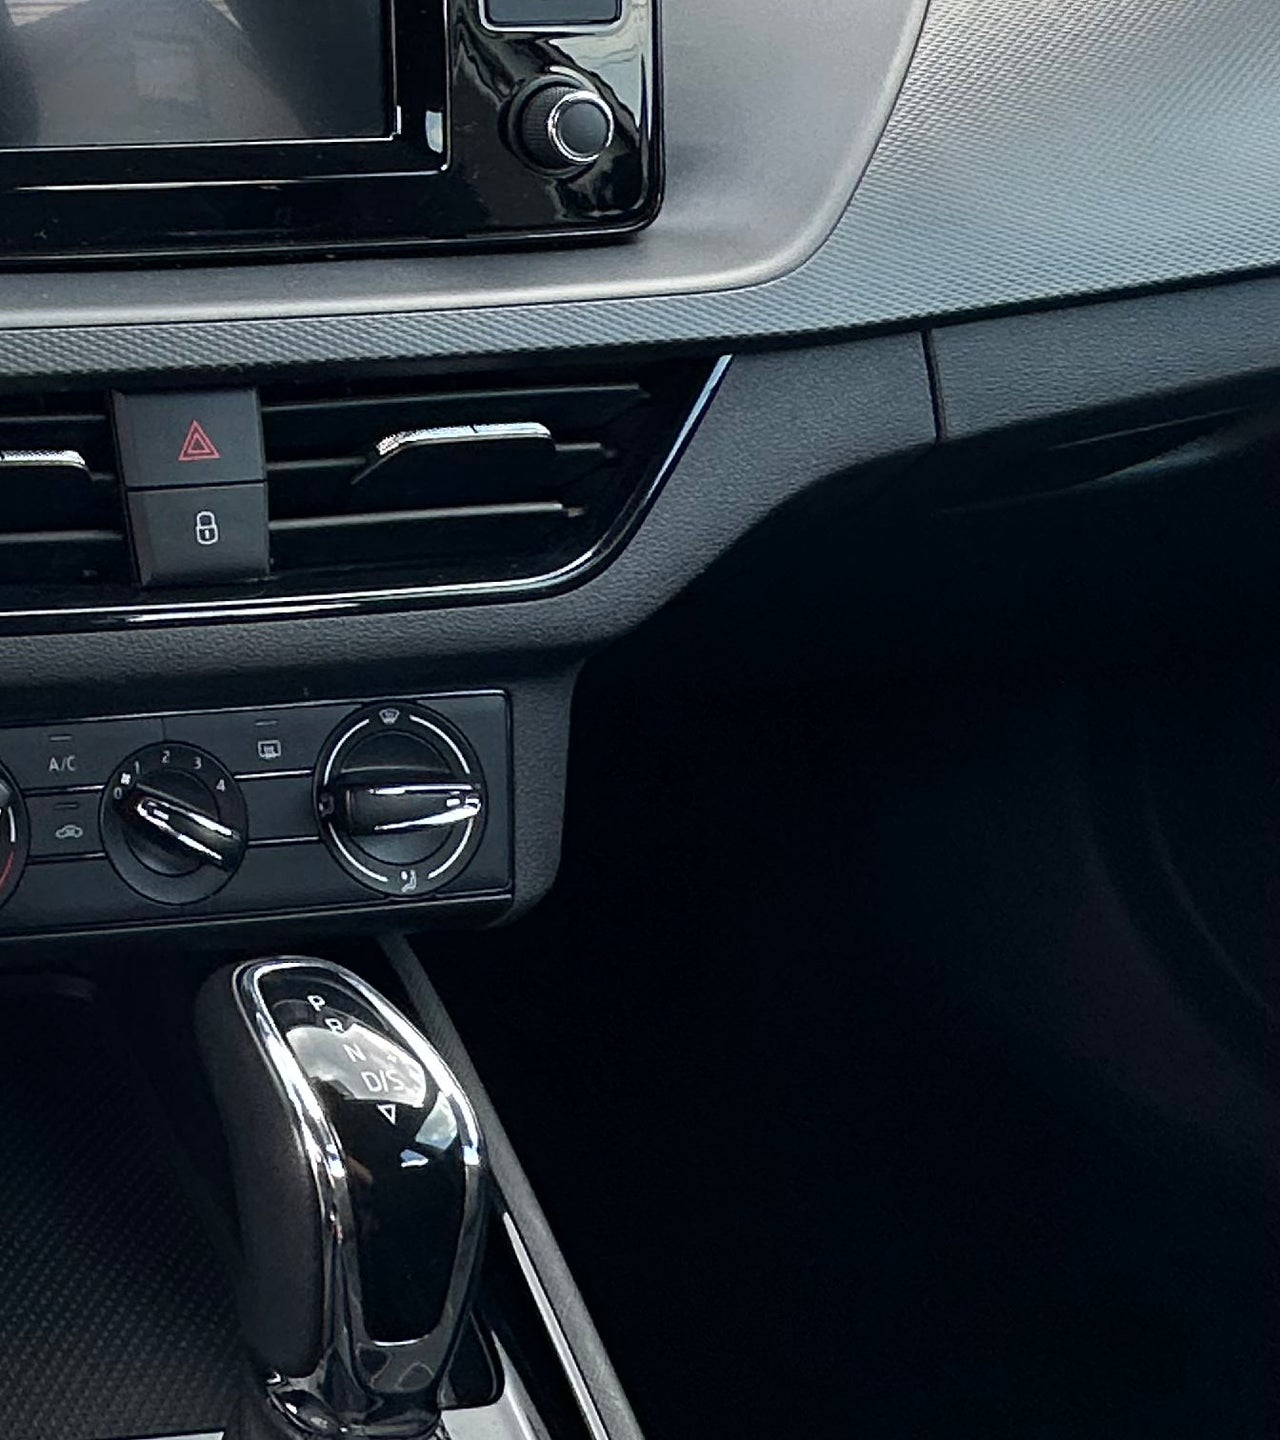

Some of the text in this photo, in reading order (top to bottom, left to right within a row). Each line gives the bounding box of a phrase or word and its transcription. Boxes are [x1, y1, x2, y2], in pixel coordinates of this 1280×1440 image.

[49, 755, 76, 771] A/C
[161, 750, 170, 764] 2
[194, 757, 202, 770] 3
[134, 760, 140, 774] 1
[216, 778, 226, 792] 4
[113, 787, 123, 799] 0
[307, 995, 325, 1011] P
[325, 1018, 344, 1034] R
[343, 1043, 367, 1063] N
[361, 1068, 404, 1092] D/S
